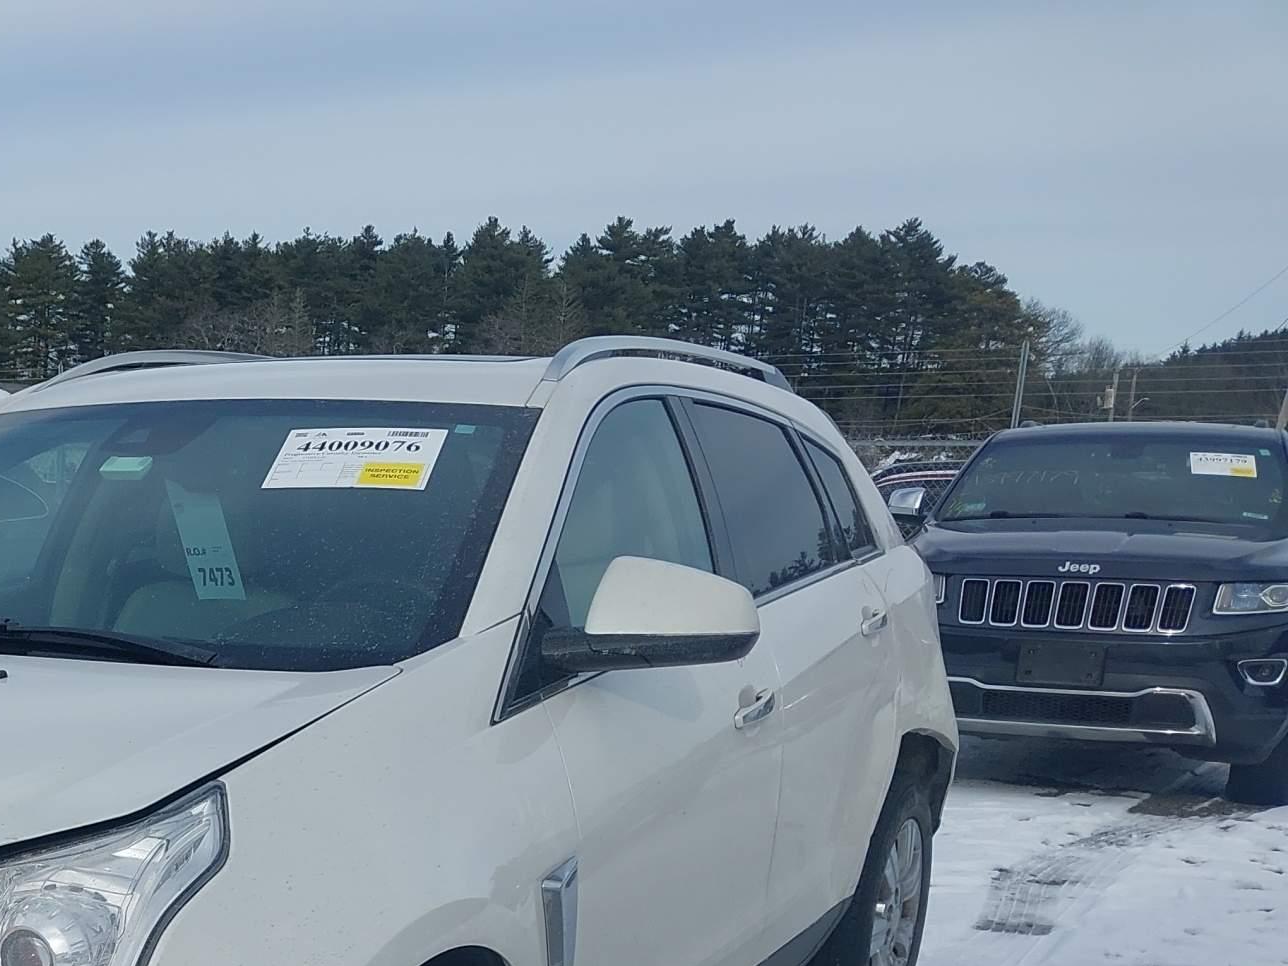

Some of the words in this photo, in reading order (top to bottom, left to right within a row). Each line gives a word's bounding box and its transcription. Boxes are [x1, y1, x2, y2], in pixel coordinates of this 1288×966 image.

[297, 440, 422, 452] 44009076
[1057, 561, 1101, 575] Jeep
[197, 567, 235, 587] 7473
